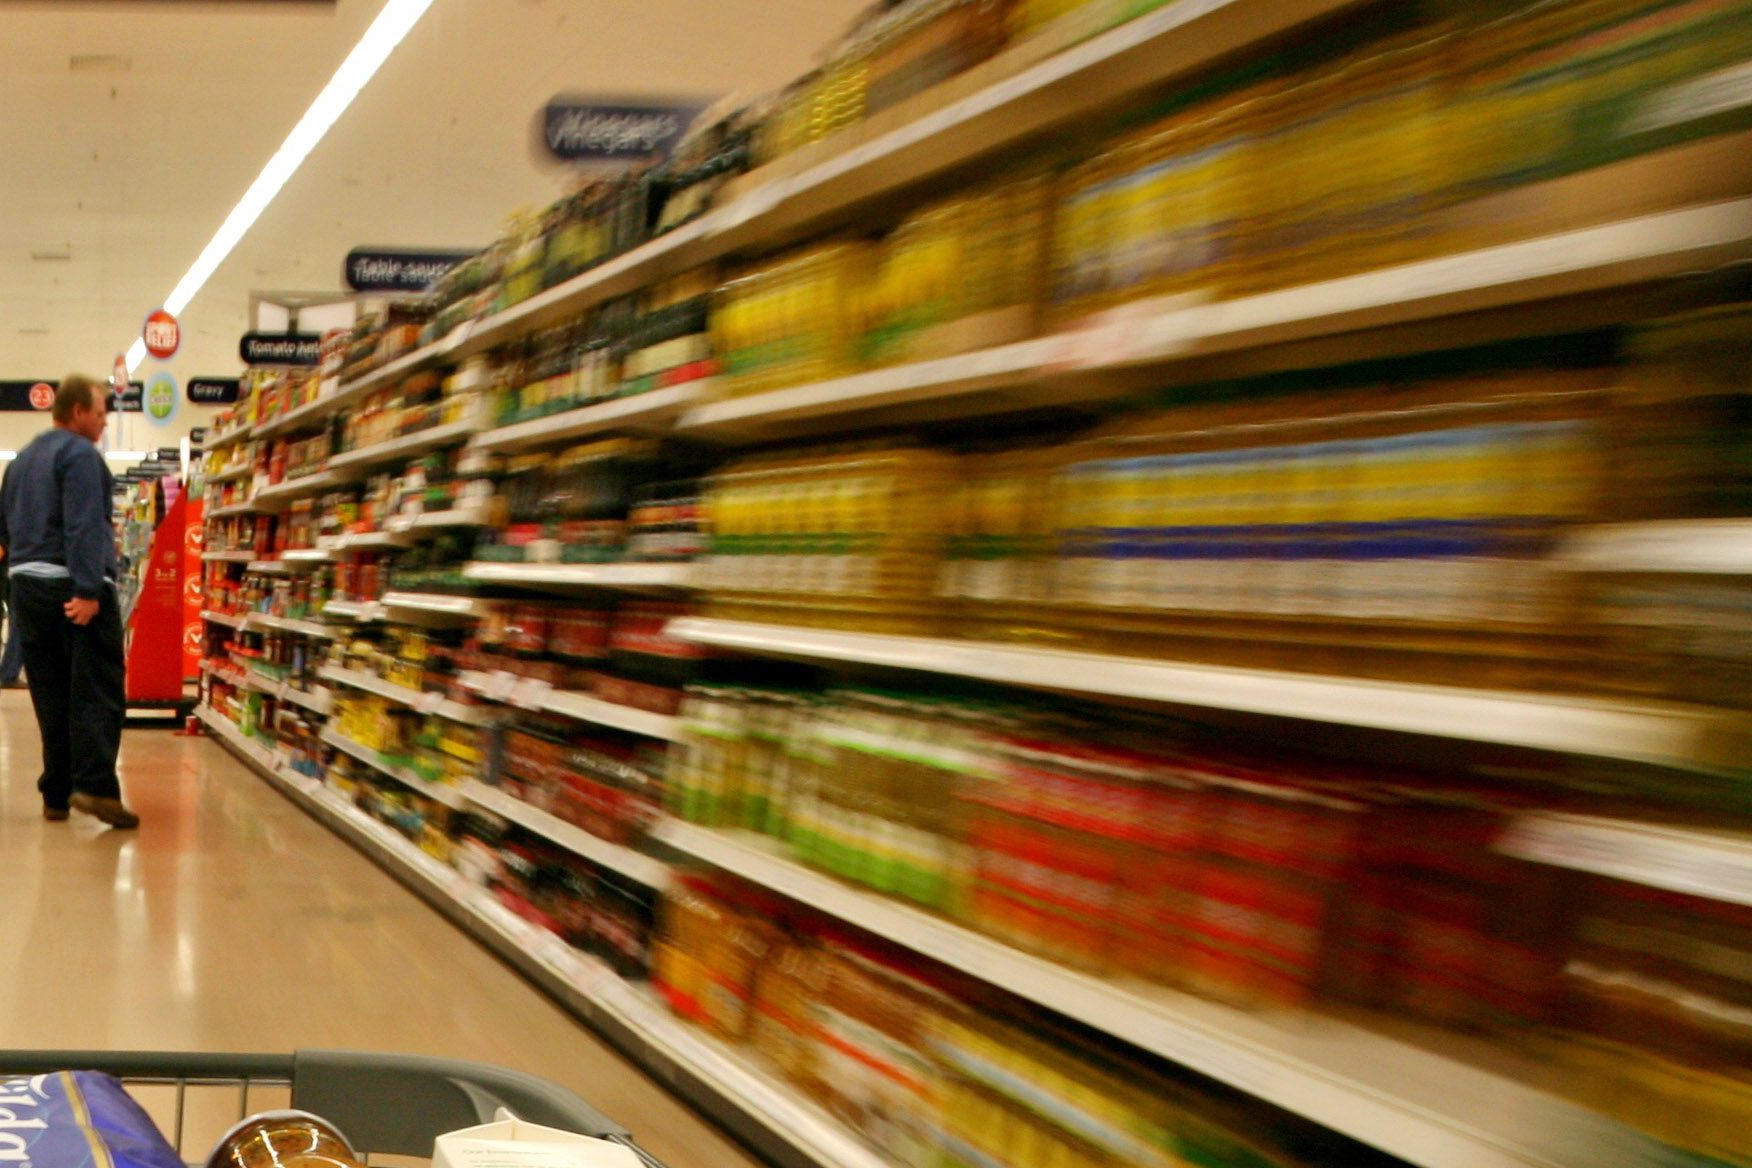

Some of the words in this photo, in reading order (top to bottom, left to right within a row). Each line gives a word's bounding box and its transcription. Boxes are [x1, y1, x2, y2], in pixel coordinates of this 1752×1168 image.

[249, 338, 296, 356] Tomato
[33, 389, 50, 403] 23
[193, 384, 224, 398] Gravy
